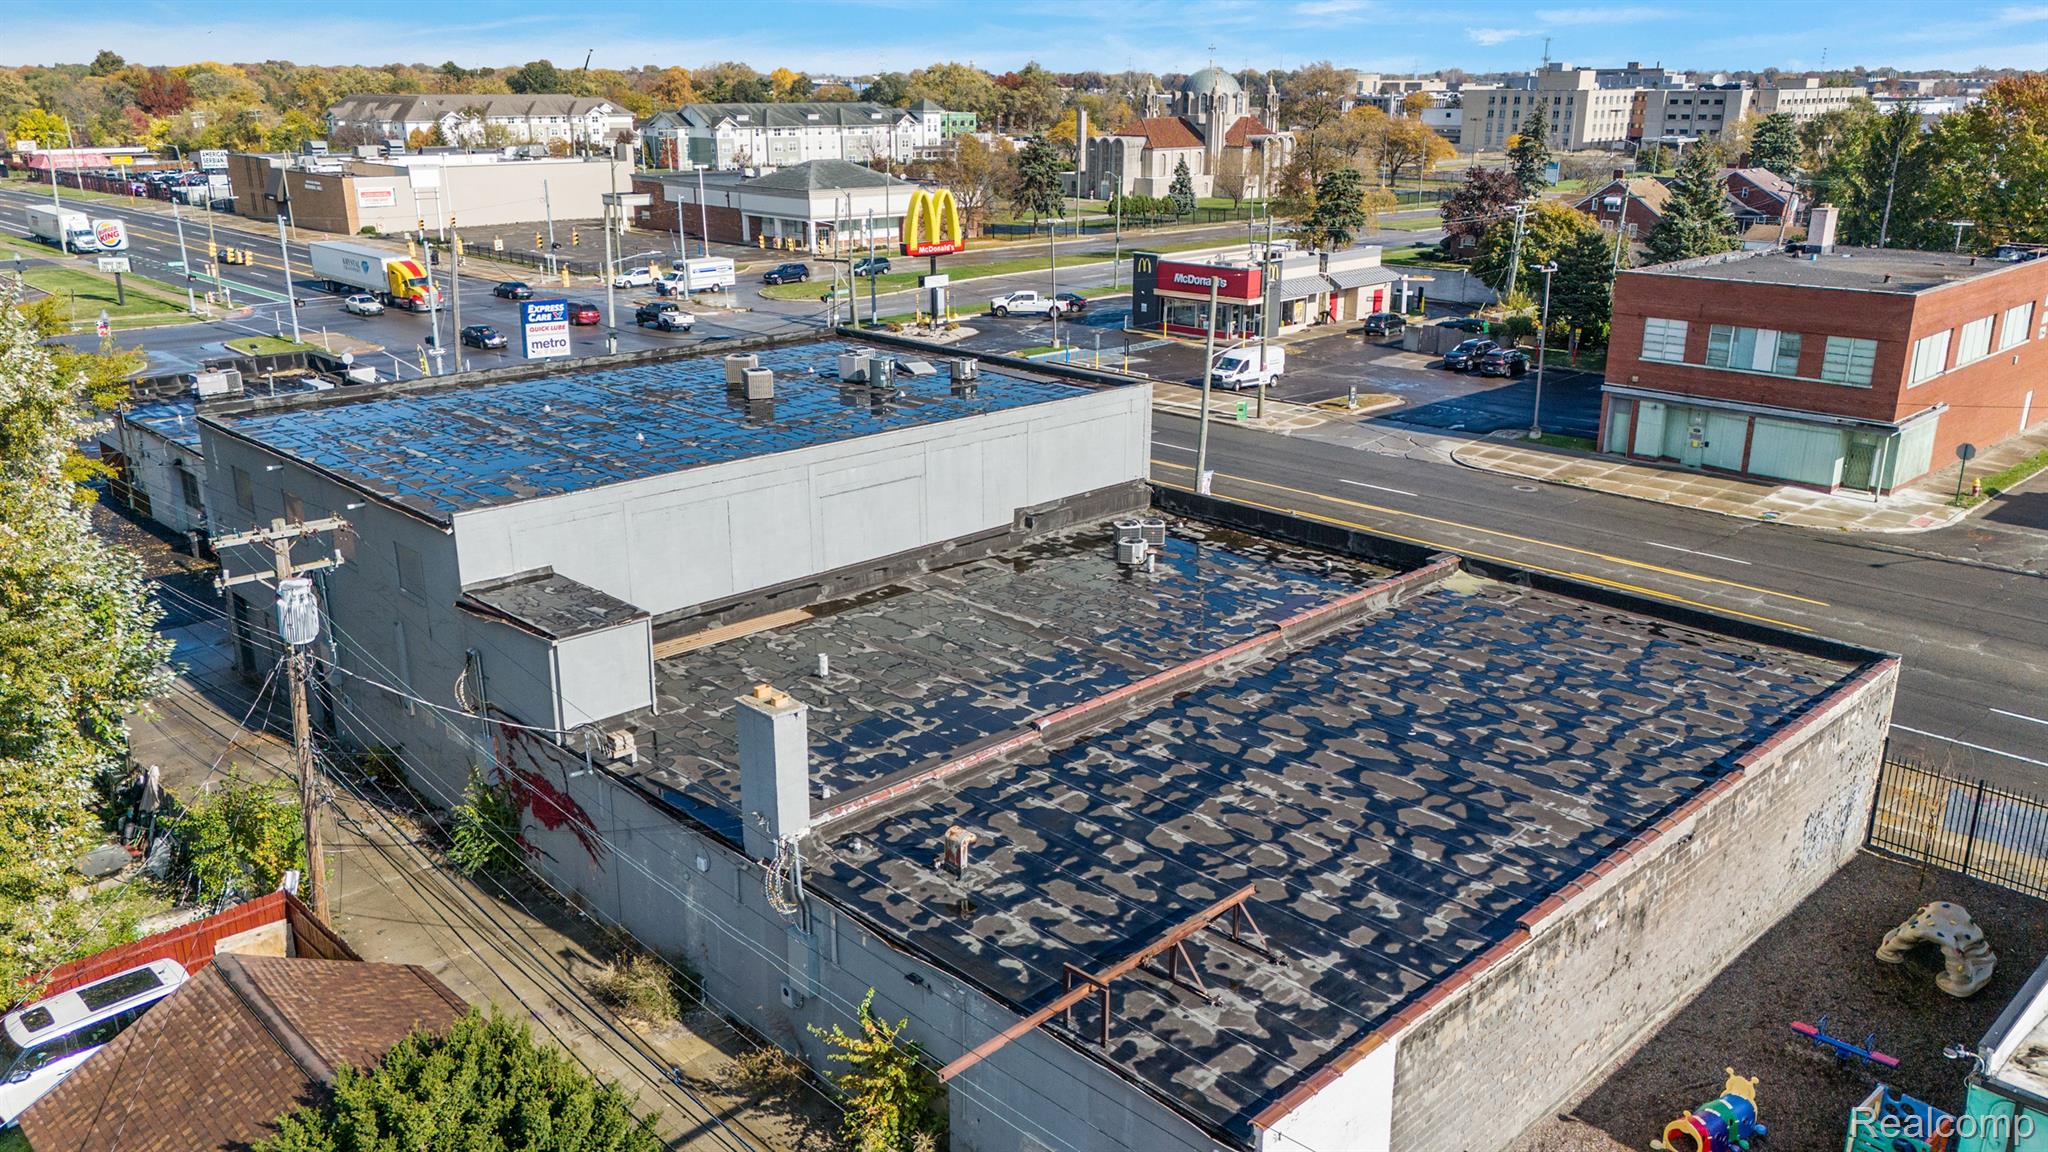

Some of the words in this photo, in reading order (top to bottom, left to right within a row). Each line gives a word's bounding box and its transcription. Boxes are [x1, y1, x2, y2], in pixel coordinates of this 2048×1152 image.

[100, 231, 120, 242] KING
[918, 244, 955, 253] McDonald's
[1174, 273, 1227, 288] McDona's
[528, 304, 565, 313] EXPRESS
[528, 313, 552, 322] CARE
[532, 338, 567, 349] metro
